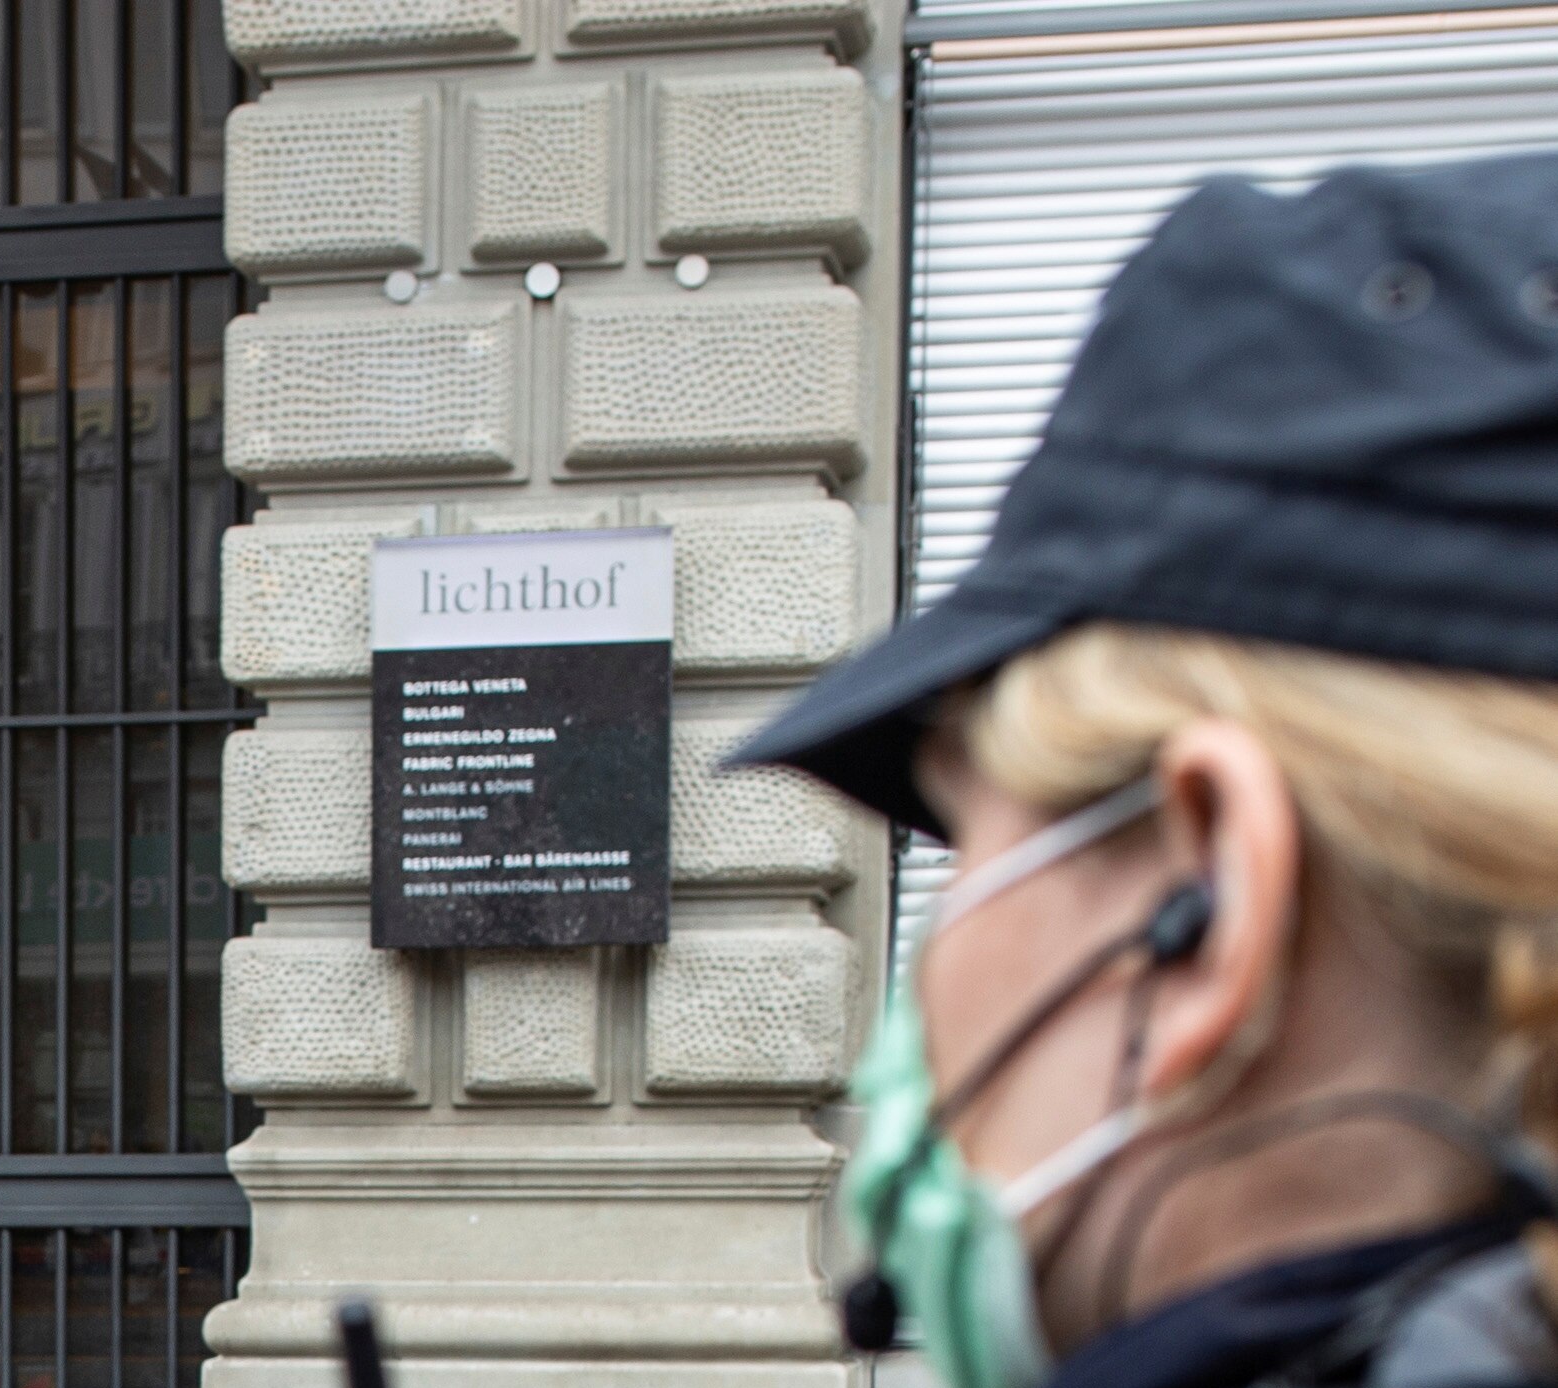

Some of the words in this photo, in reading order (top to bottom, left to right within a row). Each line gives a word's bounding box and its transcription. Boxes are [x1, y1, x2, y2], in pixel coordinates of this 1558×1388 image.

[421, 562, 625, 615] lichthof
[403, 680, 469, 696] BOTTEGA
[472, 678, 527, 694] VENETA
[403, 705, 465, 721] BULGARI
[403, 729, 505, 746] ERMENEGILDO
[507, 727, 557, 743] ZEGNA
[403, 756, 454, 771] FABRIC
[457, 753, 534, 770] FRONTLINE
[420, 781, 467, 796] LANGE
[402, 806, 488, 822] MONTBLANC
[402, 831, 462, 847] PANERAI
[402, 855, 492, 871] RESTAURANT
[503, 853, 532, 869] BAR
[403, 882, 448, 897] SWISS
[451, 879, 558, 896] INTERNATIONAL
[562, 877, 586, 893] AIR
[589, 876, 631, 892] LINES
